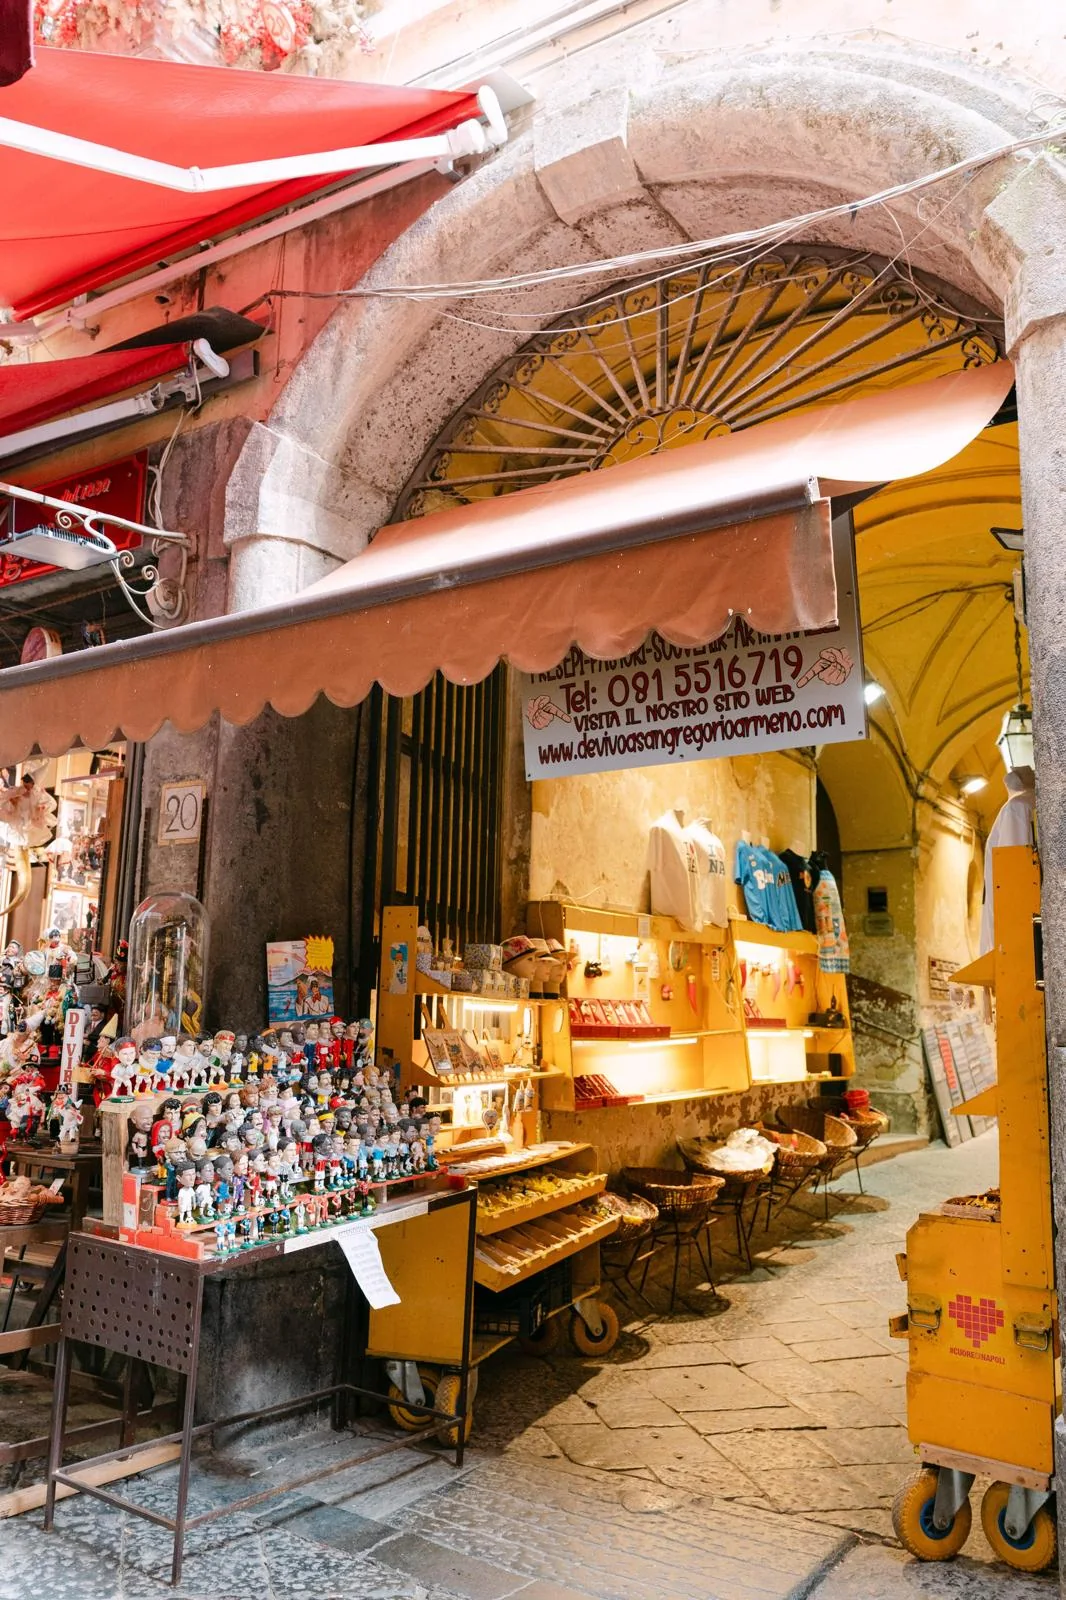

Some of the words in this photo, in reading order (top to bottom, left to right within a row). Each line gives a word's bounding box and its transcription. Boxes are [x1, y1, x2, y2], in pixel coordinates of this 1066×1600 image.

[559, 680, 597, 714] Tel:
[607, 668, 664, 707] 081
[573, 711, 621, 732] VISITA
[625, 707, 641, 726] IL
[646, 697, 708, 723] NOSTRO
[713, 691, 750, 712] SITO
[755, 684, 795, 707] WEB
[165, 793, 198, 833] 20
